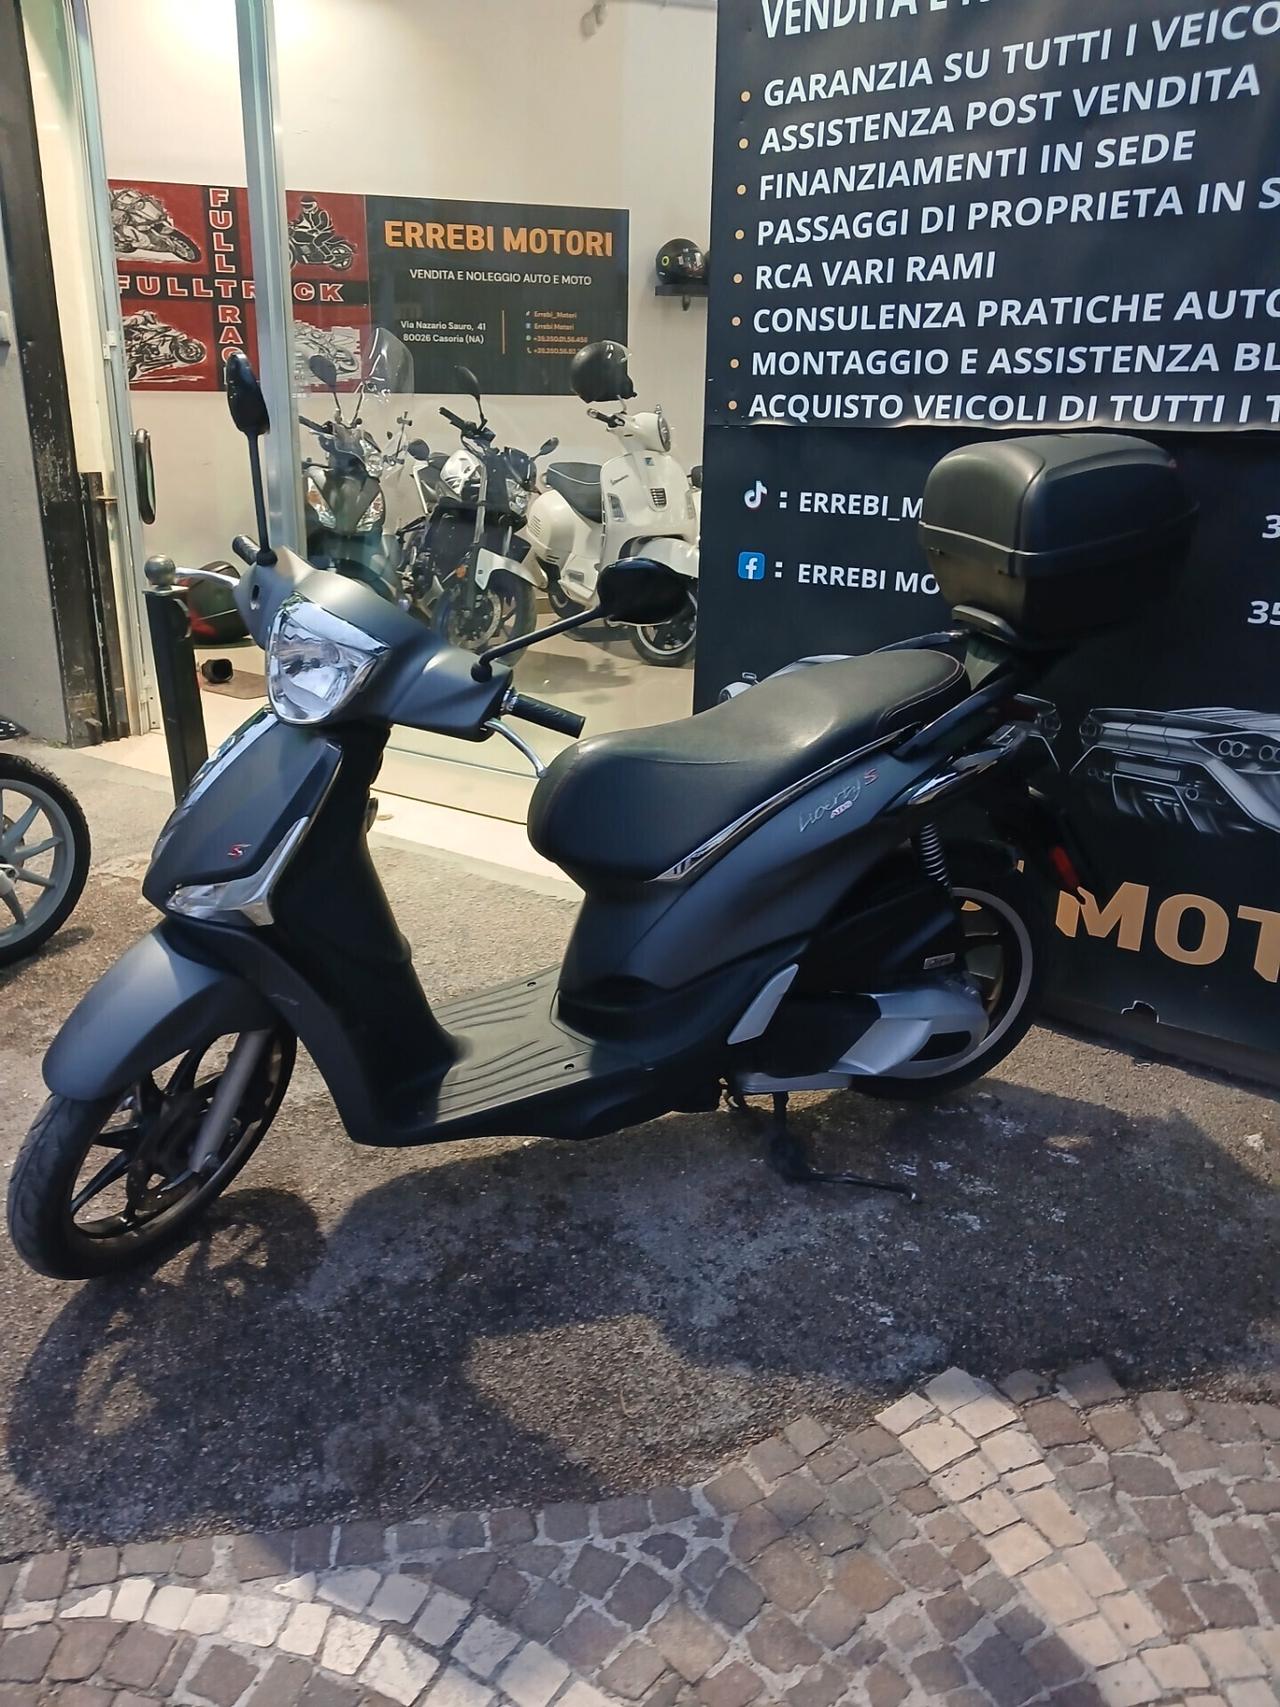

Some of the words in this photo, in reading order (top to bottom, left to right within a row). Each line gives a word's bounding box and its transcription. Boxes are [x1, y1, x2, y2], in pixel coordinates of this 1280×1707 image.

[763, 57, 933, 107] GARANZIA
[943, 47, 991, 83] SU
[1002, 28, 1112, 75] TUTTI
[1125, 23, 1138, 57] I
[1151, 0, 1280, 52] VEICO
[759, 105, 955, 155] ASSISTENZA
[966, 90, 1062, 131] POST
[1072, 63, 1260, 118] VENDITA
[759, 146, 1028, 200] FINANZIAMENTI
[1040, 141, 1083, 174] IN
[1094, 129, 1197, 169] SEDE
[757, 208, 909, 246] PASSAGGI
[920, 204, 956, 234] DI
[967, 186, 1184, 231] PROPRIETA
[1197, 180, 1246, 214] IN
[1258, 177, 1280, 209] S
[384, 220, 494, 251] ERREBI
[503, 226, 613, 257] MOTORI
[209, 188, 244, 385] FULLTRA
[409, 269, 455, 281] VENDITA
[457, 270, 464, 281] E
[466, 271, 521, 283] NOLEGGIO
[523, 273, 551, 284] AUTO
[553, 275, 560, 285] E
[561, 275, 592, 286] MOTO
[755, 262, 812, 290] RCA
[821, 257, 895, 287] VARI
[906, 250, 996, 283] RAMI
[117, 275, 344, 302] FULLTRCK
[400, 320, 414, 329] Via
[416, 321, 447, 330] Nazario
[448, 322, 474, 331] Sauro,
[477, 322, 486, 331] 41
[753, 301, 966, 333] CONSULENZA
[977, 292, 1165, 327] PRATICHE
[433, 334, 464, 343] Casoria
[465, 334, 484, 344] (NA)
[752, 348, 949, 376] MONTAGGIO
[960, 348, 978, 374] E
[986, 343, 1220, 374] ASSISTENZA
[1233, 342, 1280, 372] BL
[748, 394, 904, 426] ACQUISTO
[913, 394, 1047, 421] VEICOLI
[1058, 395, 1098, 422] DI
[1111, 394, 1225, 423] TUTTI
[1238, 395, 1251, 423] I
[800, 491, 923, 522] ERREBI_M
[798, 563, 887, 590] ERREBI
[895, 571, 940, 595] MO
